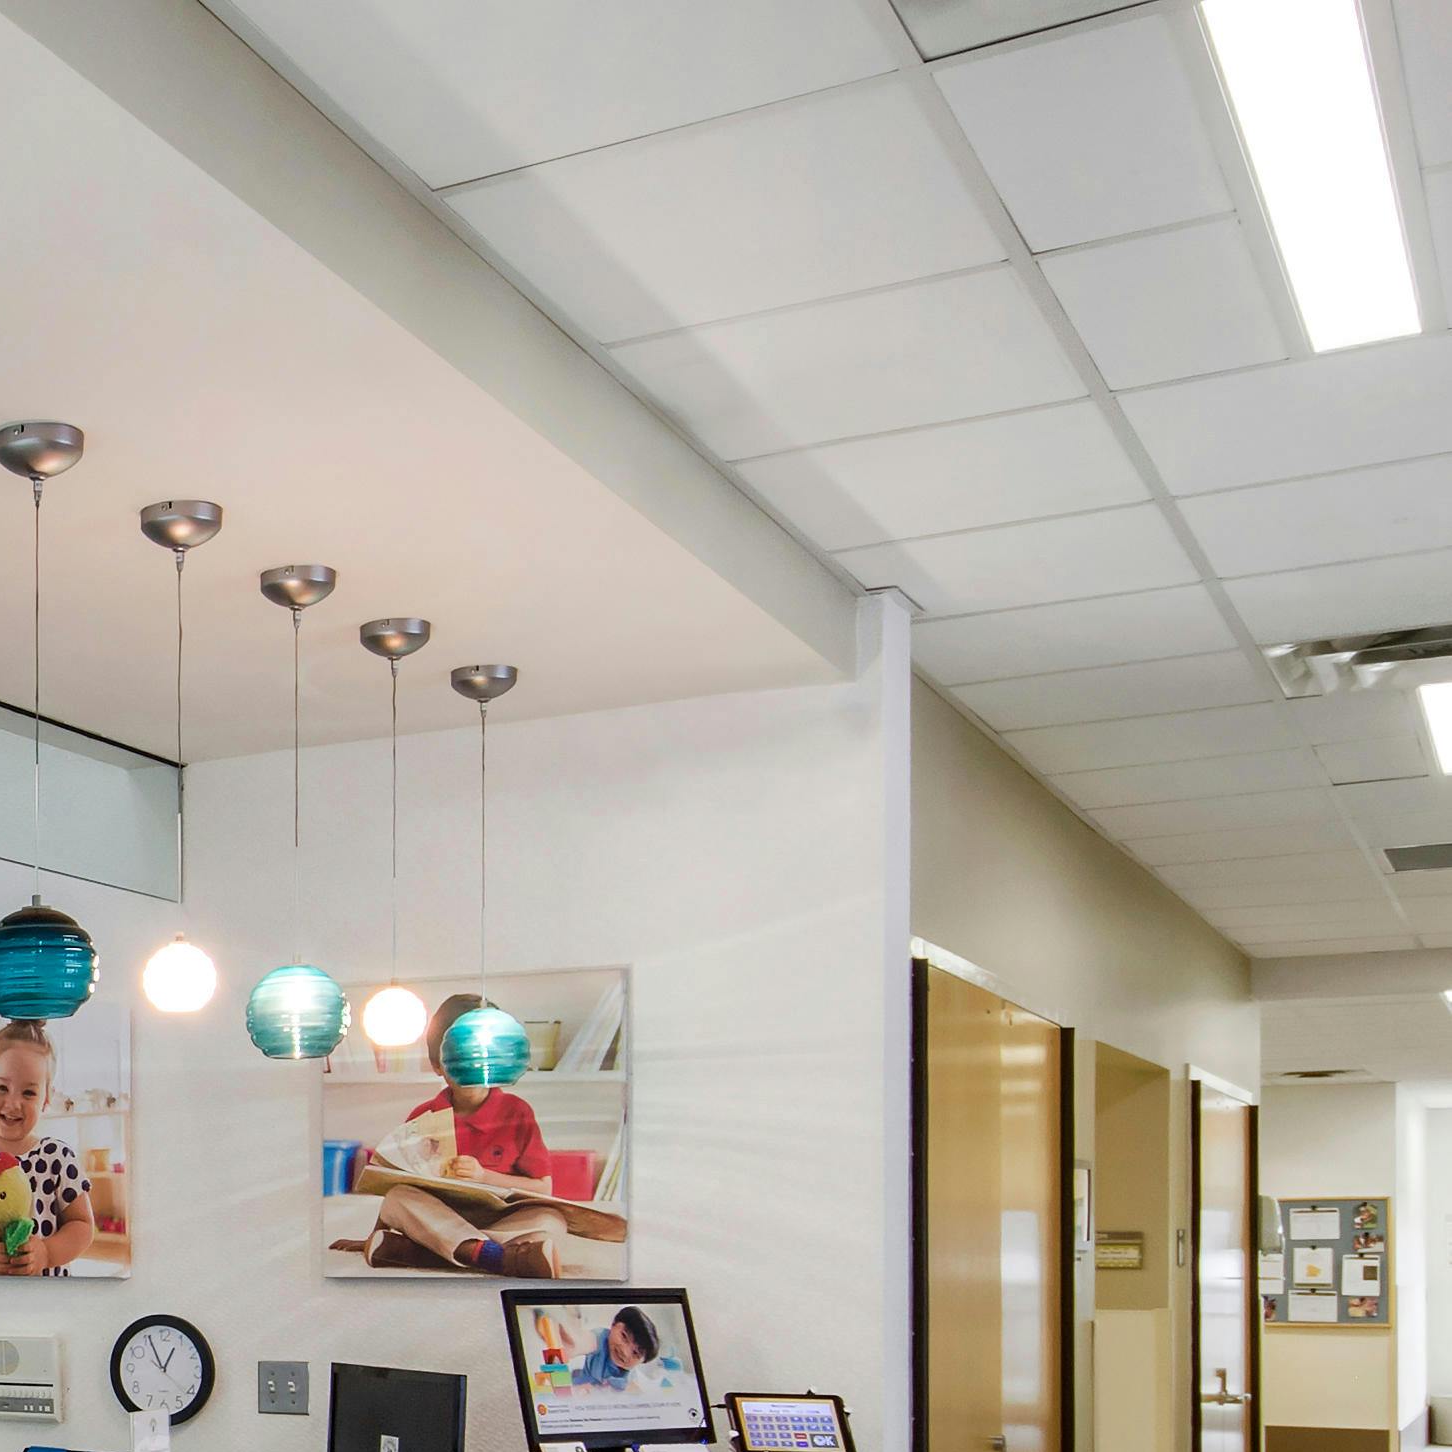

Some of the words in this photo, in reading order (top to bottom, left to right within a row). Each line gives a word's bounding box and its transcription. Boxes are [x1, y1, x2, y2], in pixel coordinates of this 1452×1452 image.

[159, 1329, 171, 1342] 12
[129, 1346, 145, 1359] 10
[126, 1363, 135, 1375] 9
[132, 1381, 140, 1393] 8
[186, 1384, 195, 1395] 4
[146, 1394, 153, 1408] 7
[175, 1395, 184, 1409] 5
[814, 1435, 836, 1447] OK
